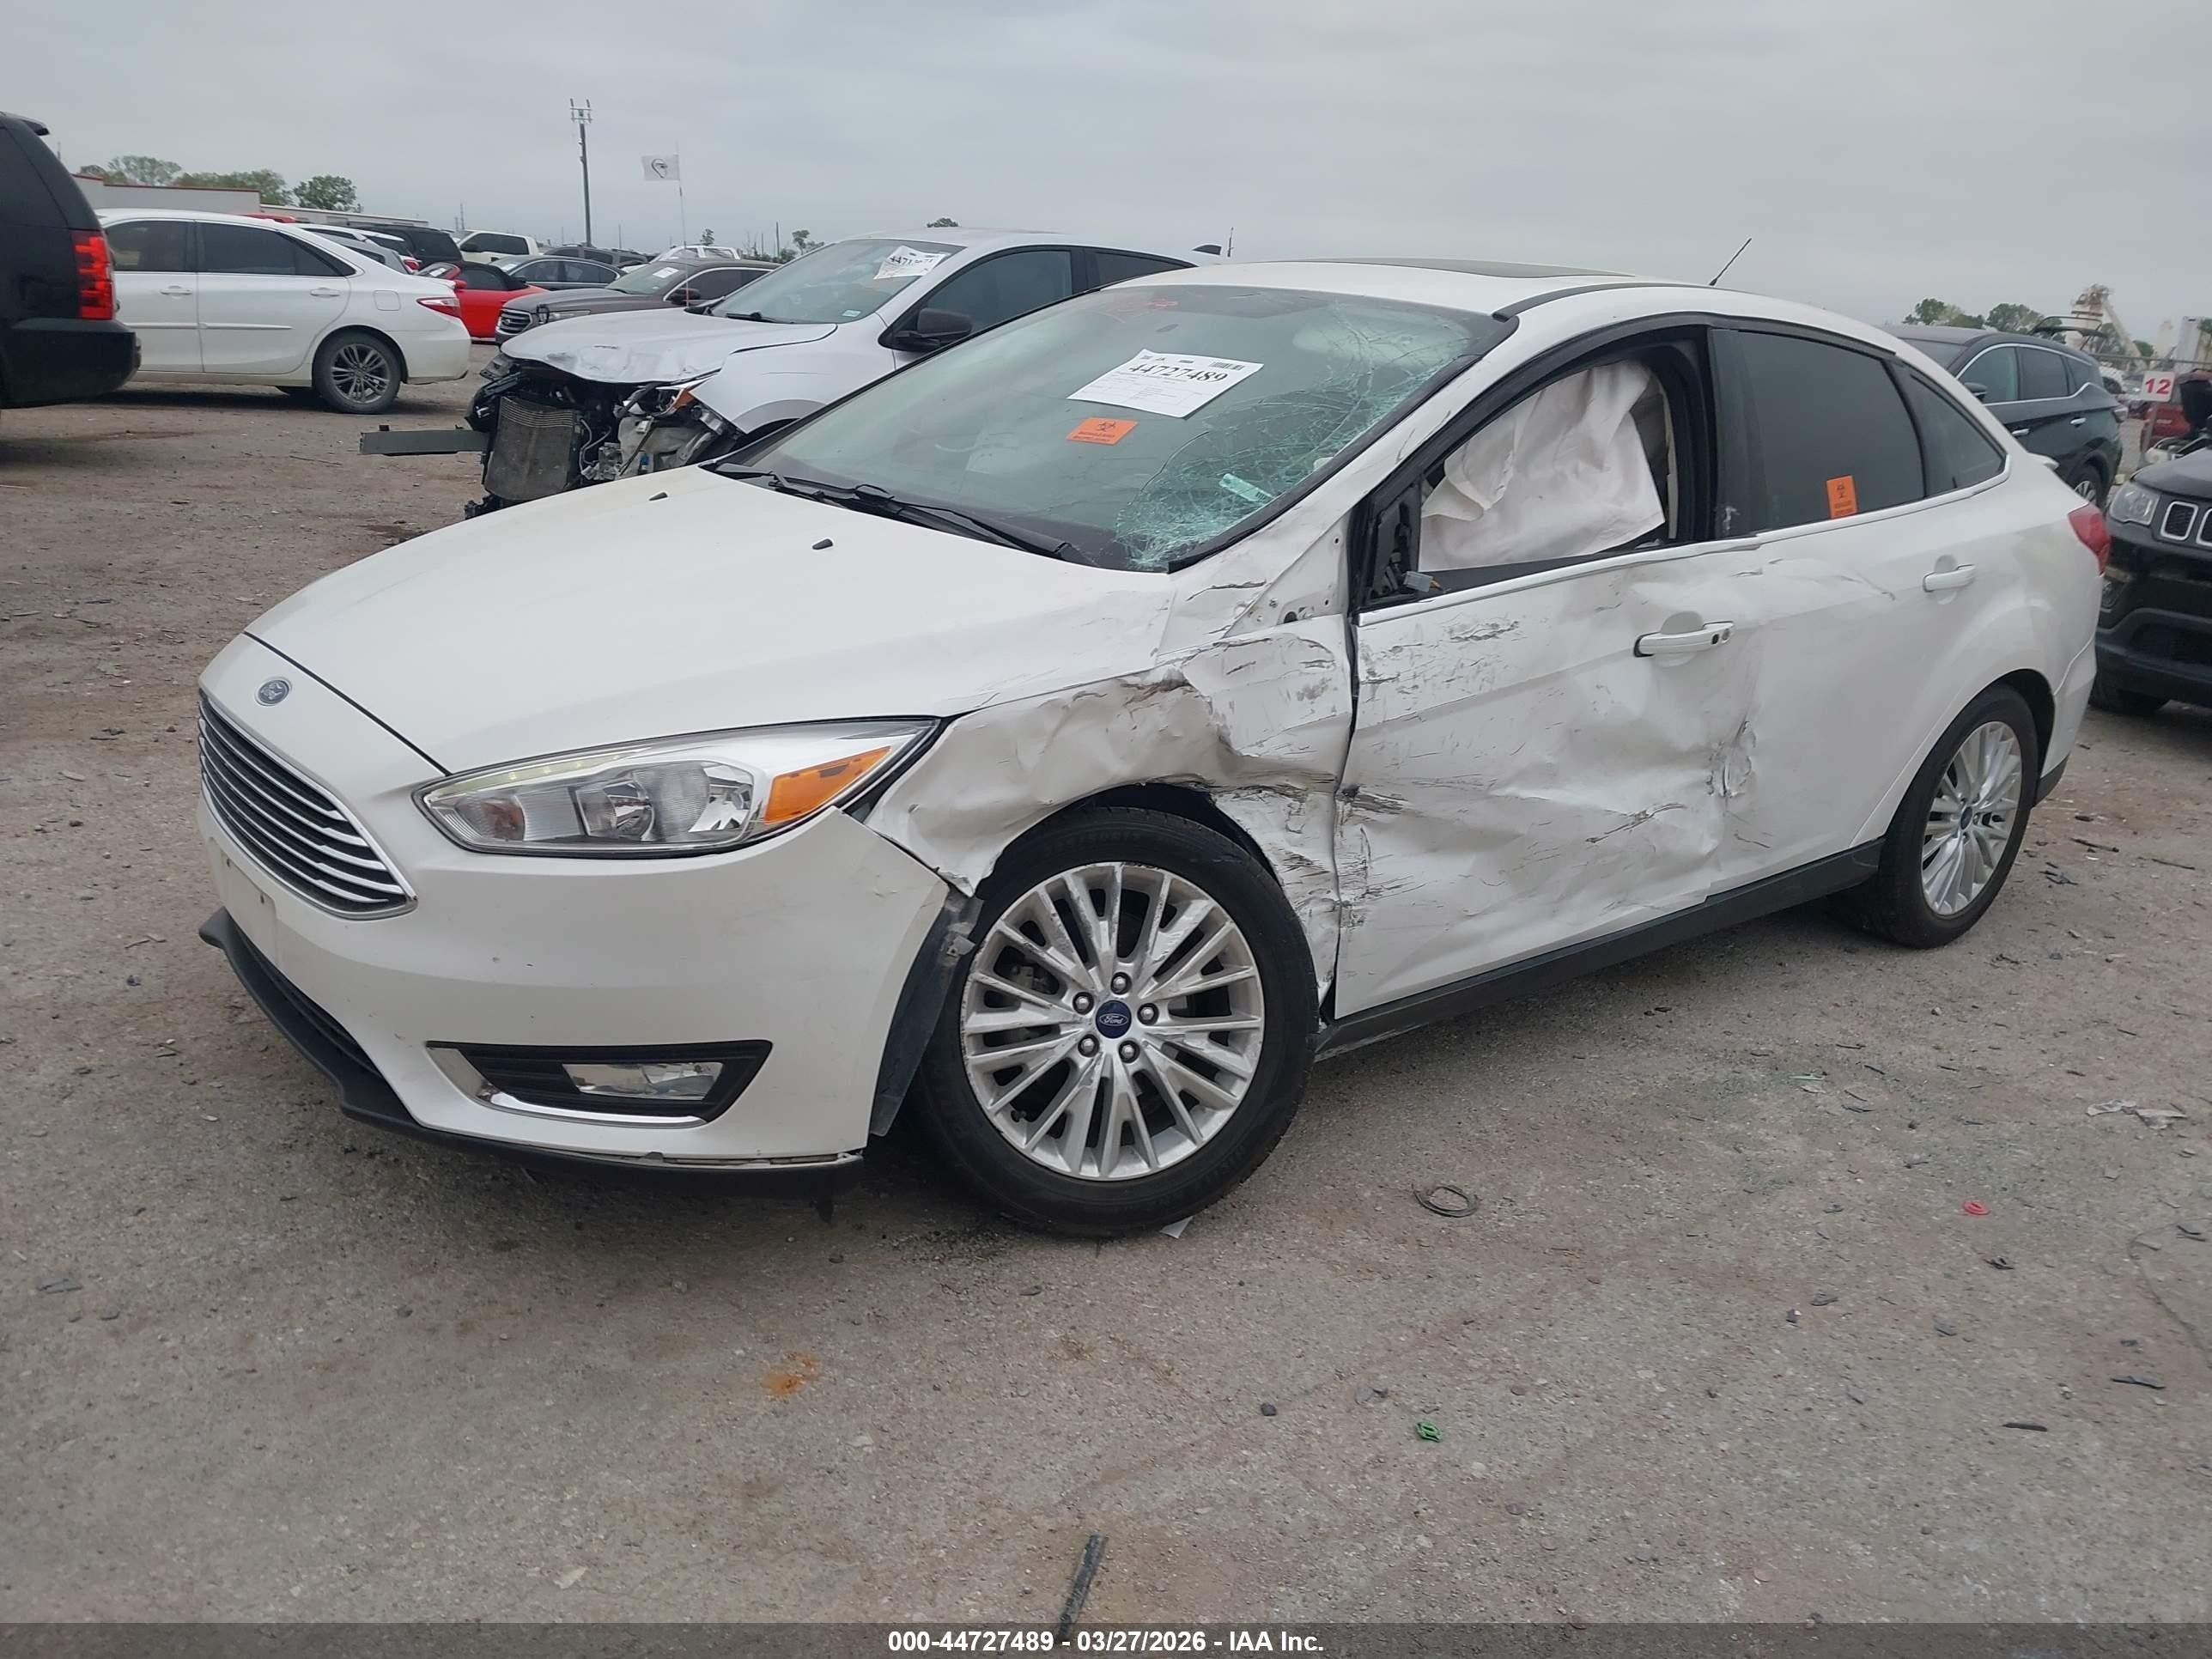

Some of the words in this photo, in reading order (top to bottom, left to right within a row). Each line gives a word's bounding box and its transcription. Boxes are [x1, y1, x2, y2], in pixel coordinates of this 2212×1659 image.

[1128, 363, 1228, 382] 44727489
[2145, 378, 2172, 394] 12
[1104, 1015, 1123, 1024] Ford
